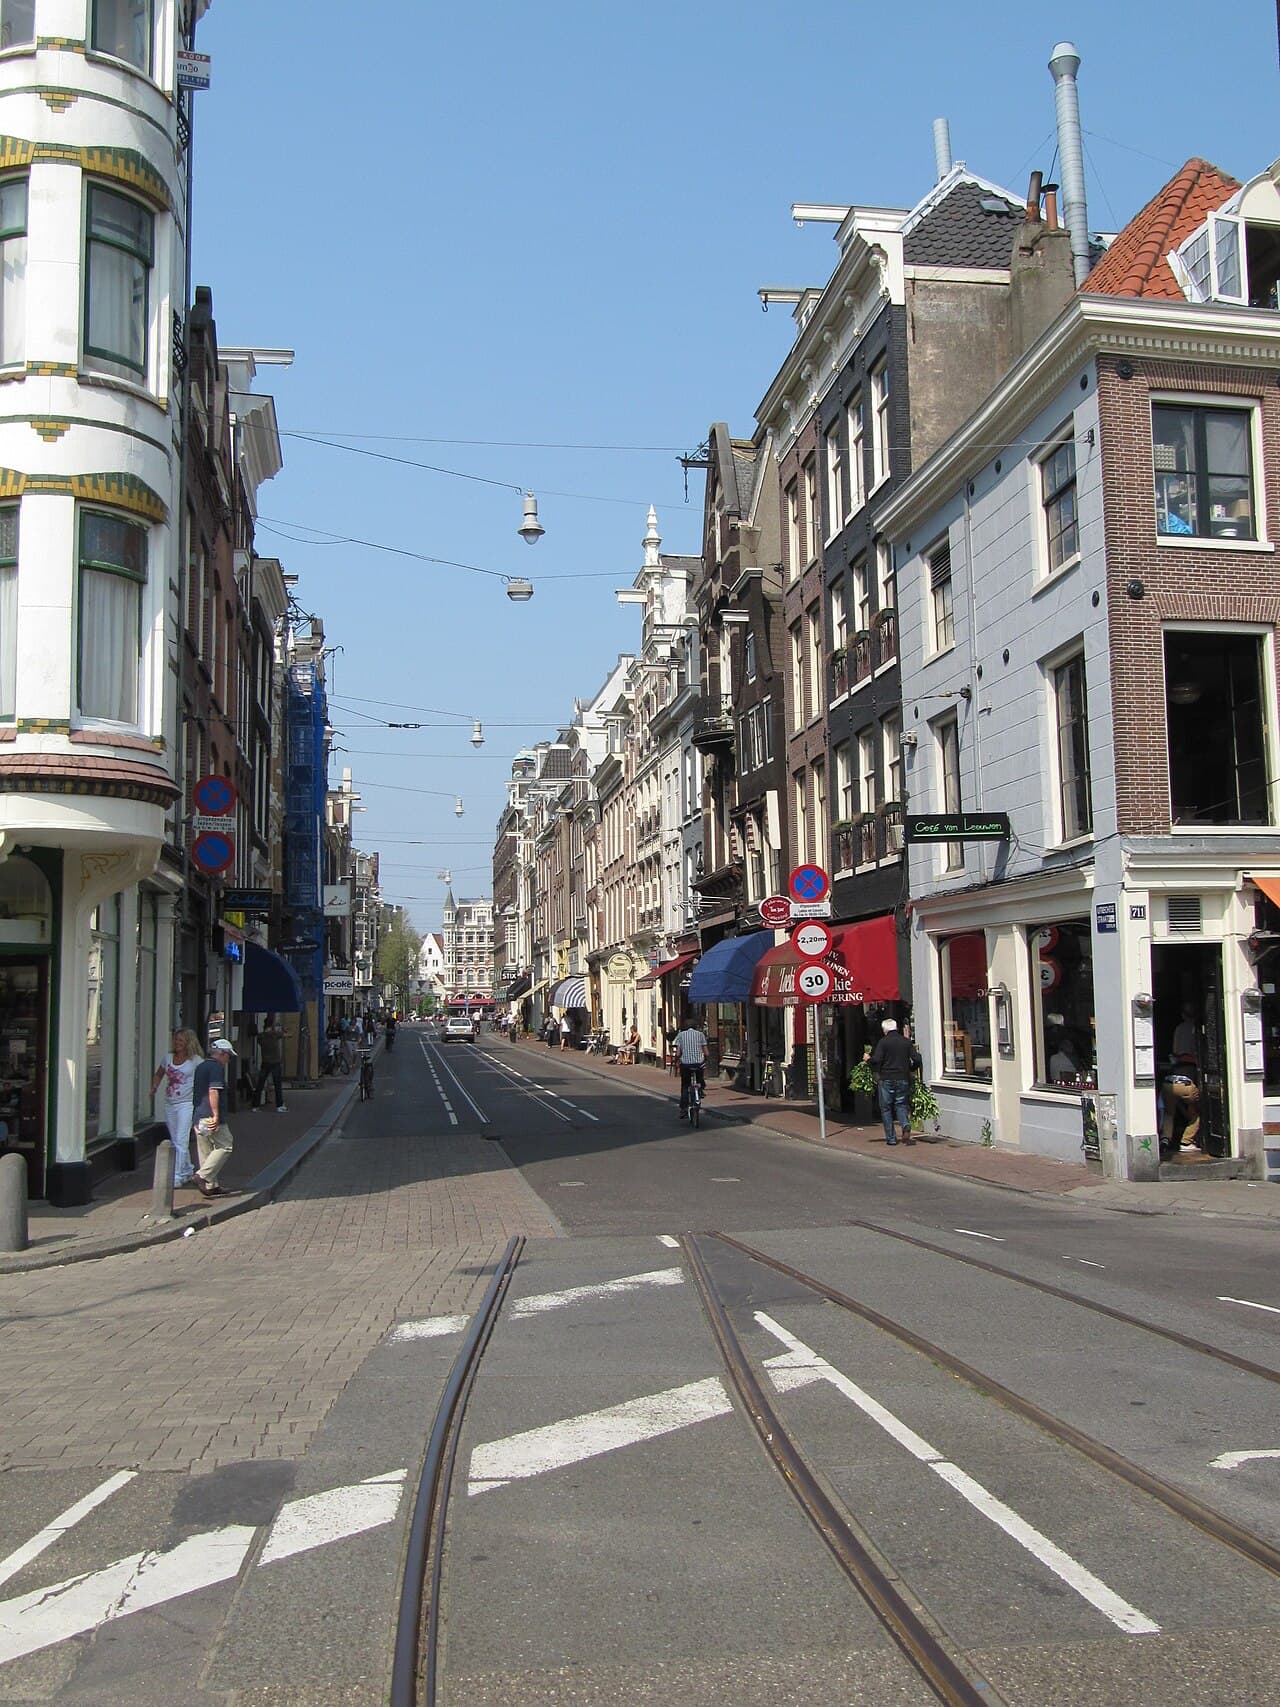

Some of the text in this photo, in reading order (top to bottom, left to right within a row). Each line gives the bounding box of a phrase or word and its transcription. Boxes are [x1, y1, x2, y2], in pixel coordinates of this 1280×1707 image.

[1131, 907, 1145, 917] 711
[804, 975, 824, 987] 30
[824, 992, 864, 1002] TERING
